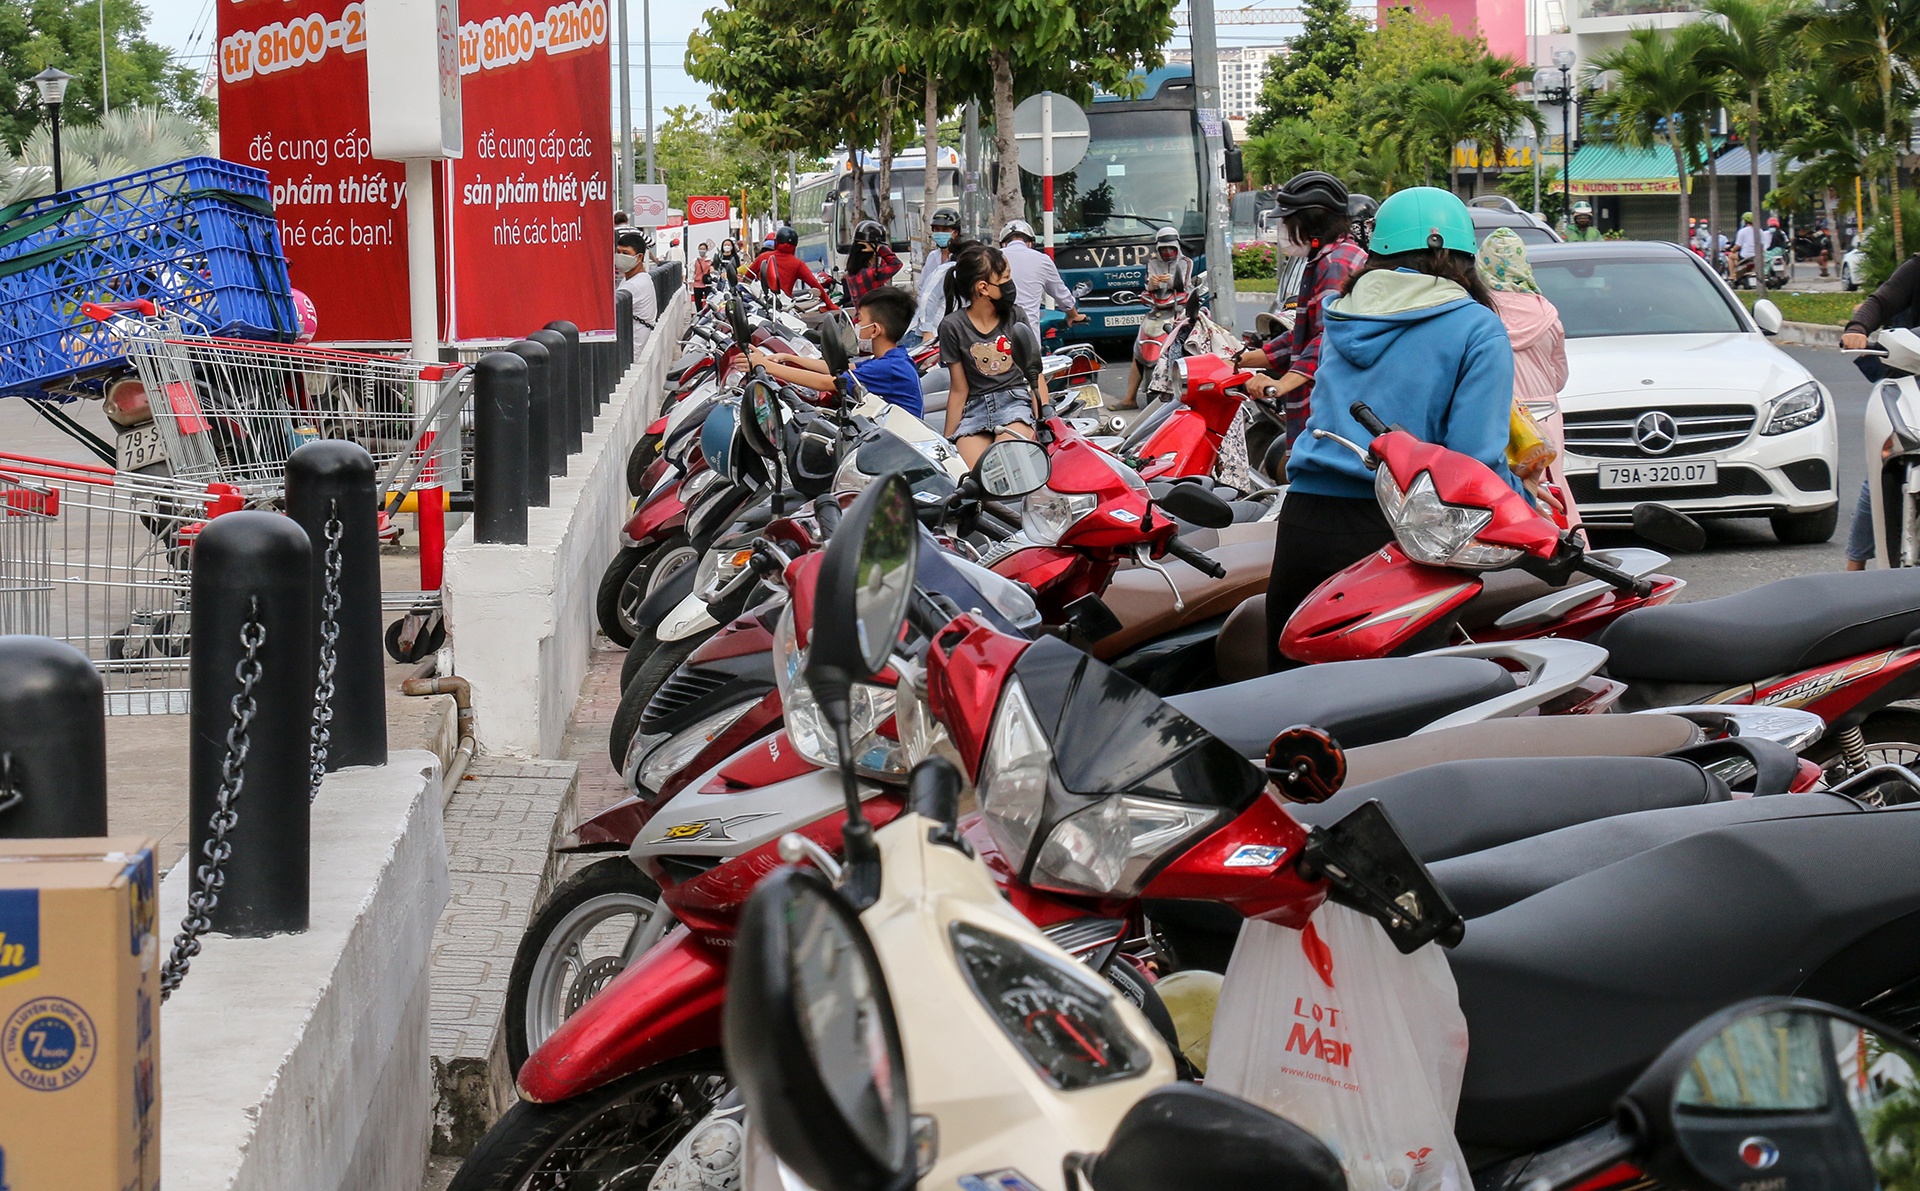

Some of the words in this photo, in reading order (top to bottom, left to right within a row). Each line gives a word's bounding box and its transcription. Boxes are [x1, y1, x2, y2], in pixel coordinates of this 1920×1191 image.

[222, 36, 252, 76] từ
[256, 19, 325, 68] 8h00
[459, 28, 480, 68] từ
[482, 18, 534, 63] 8h00
[547, 3, 606, 47] 22h00
[248, 131, 273, 161] để
[278, 139, 328, 166] cung
[334, 128, 370, 165] cấp
[477, 129, 496, 159] để
[500, 136, 535, 165] cung
[539, 128, 566, 164] cấp
[568, 131, 592, 157] các
[272, 174, 333, 211] phẩm
[338, 172, 388, 203] thiết
[463, 174, 492, 205] sản
[495, 173, 539, 210] phẩm
[542, 172, 578, 203] thiết
[579, 172, 607, 208] yếu
[691, 200, 726, 219] GO!
[278, 219, 307, 246] hé
[311, 219, 345, 246] các
[350, 218, 393, 251] bạn!
[493, 218, 521, 245] nhé
[523, 218, 548, 244] các
[551, 216, 582, 248] bạn!
[1104, 271, 1142, 280] THACO
[125, 426, 159, 450] 79-S
[125, 444, 164, 468] 797
[1609, 465, 1706, 484] 79A-320.07
[768, 739, 781, 762] NDA
[704, 935, 738, 947] HON
[1293, 997, 1341, 1028] LOT
[28, 1031, 47, 1058] 7
[1285, 1022, 1352, 1068] Mar
